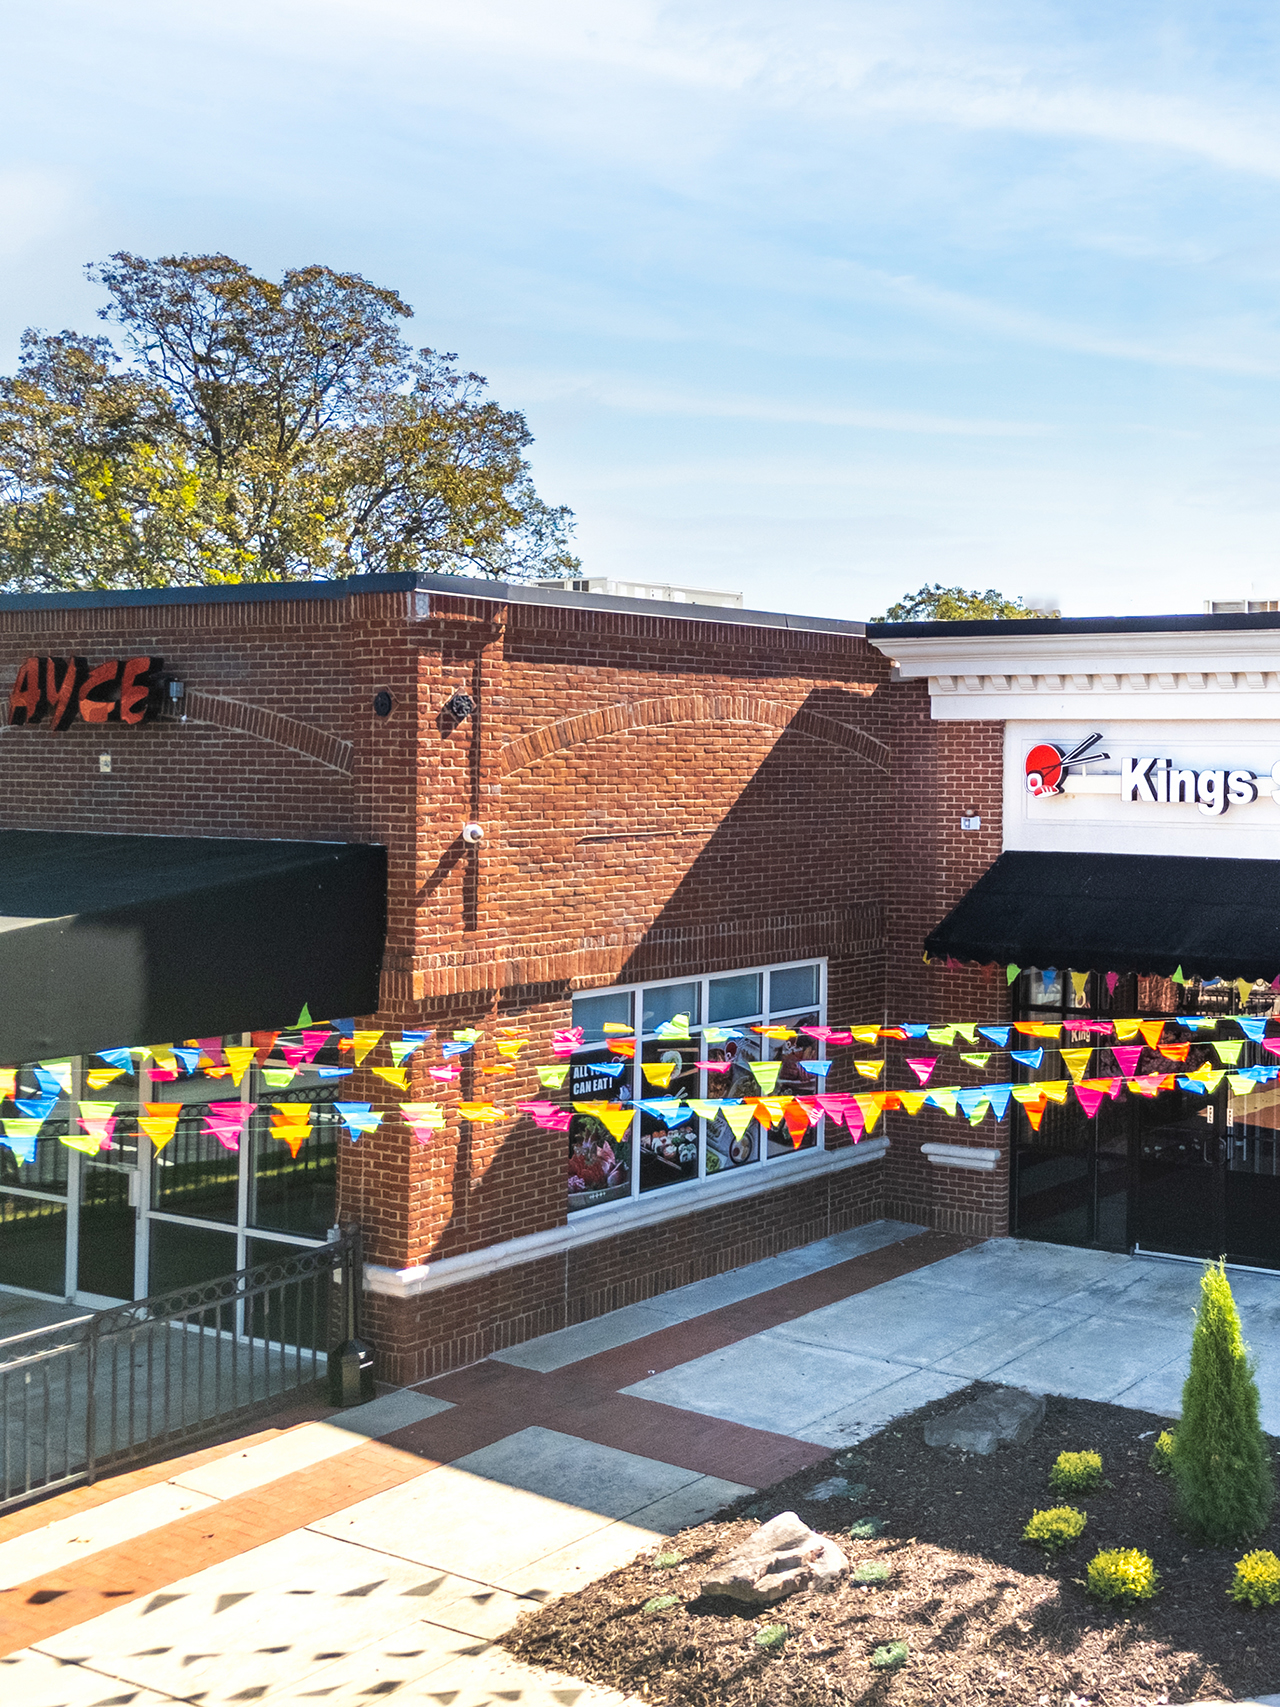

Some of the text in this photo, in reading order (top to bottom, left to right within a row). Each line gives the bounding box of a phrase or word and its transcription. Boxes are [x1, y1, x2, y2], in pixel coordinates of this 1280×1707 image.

[8, 656, 152, 732] AYCE
[1121, 757, 1258, 816] Kings
[573, 1081, 591, 1095] CAN
